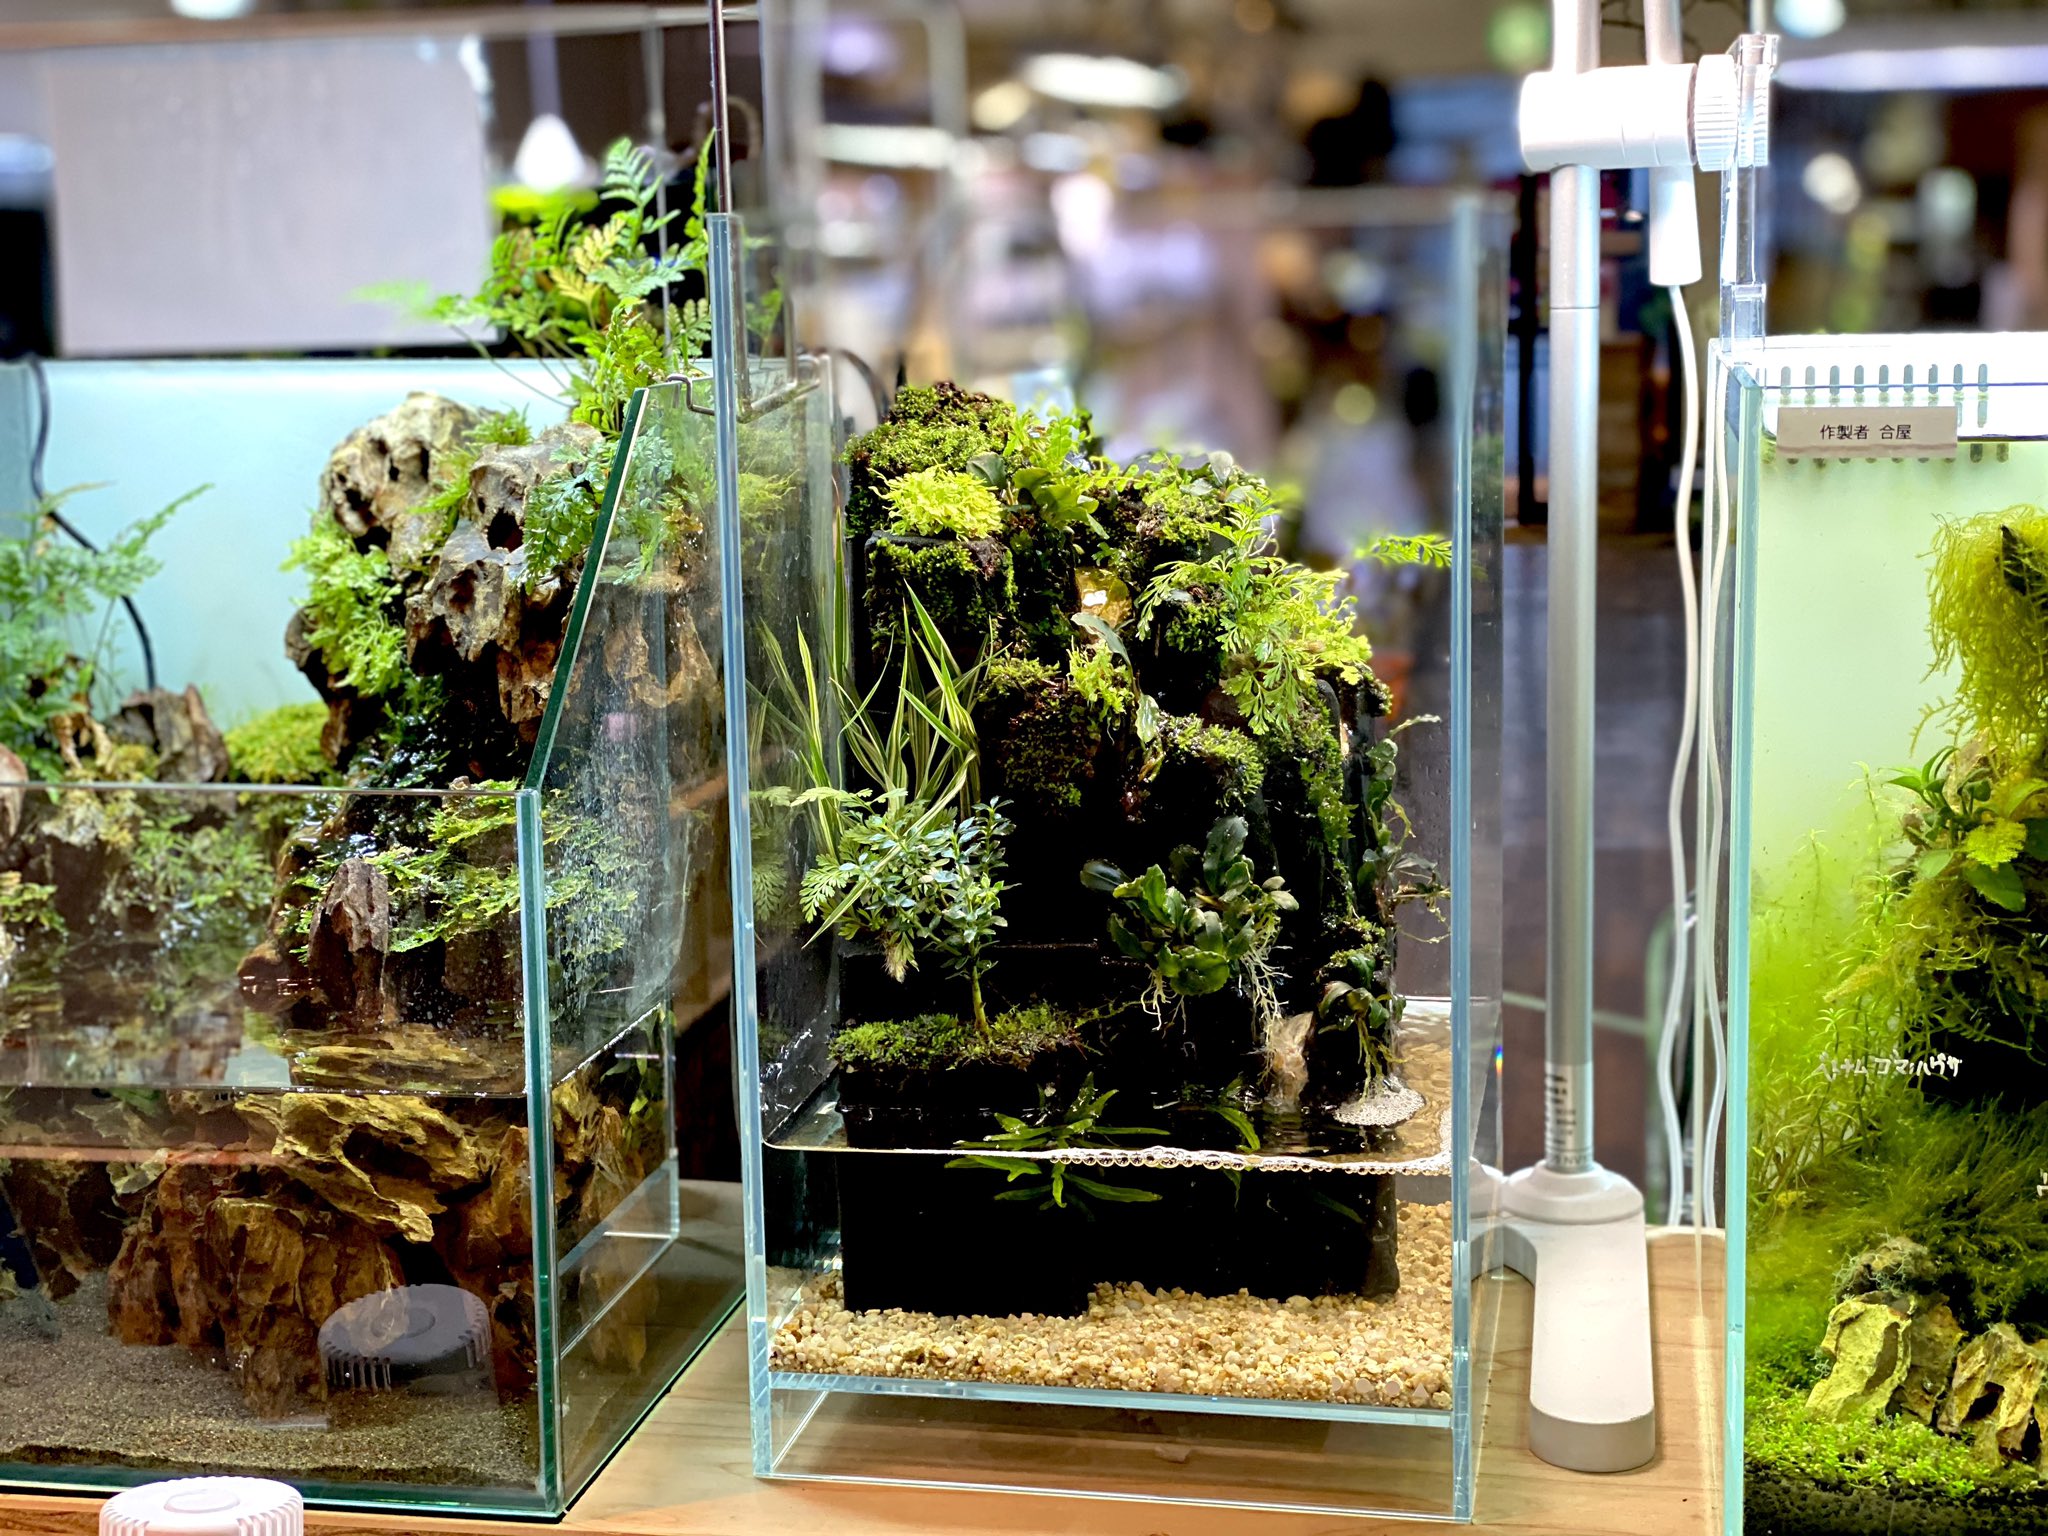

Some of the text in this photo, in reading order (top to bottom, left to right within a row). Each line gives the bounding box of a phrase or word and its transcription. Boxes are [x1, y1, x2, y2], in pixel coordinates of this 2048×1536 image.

[1820, 423, 1912, 440] 作製者 合屋
